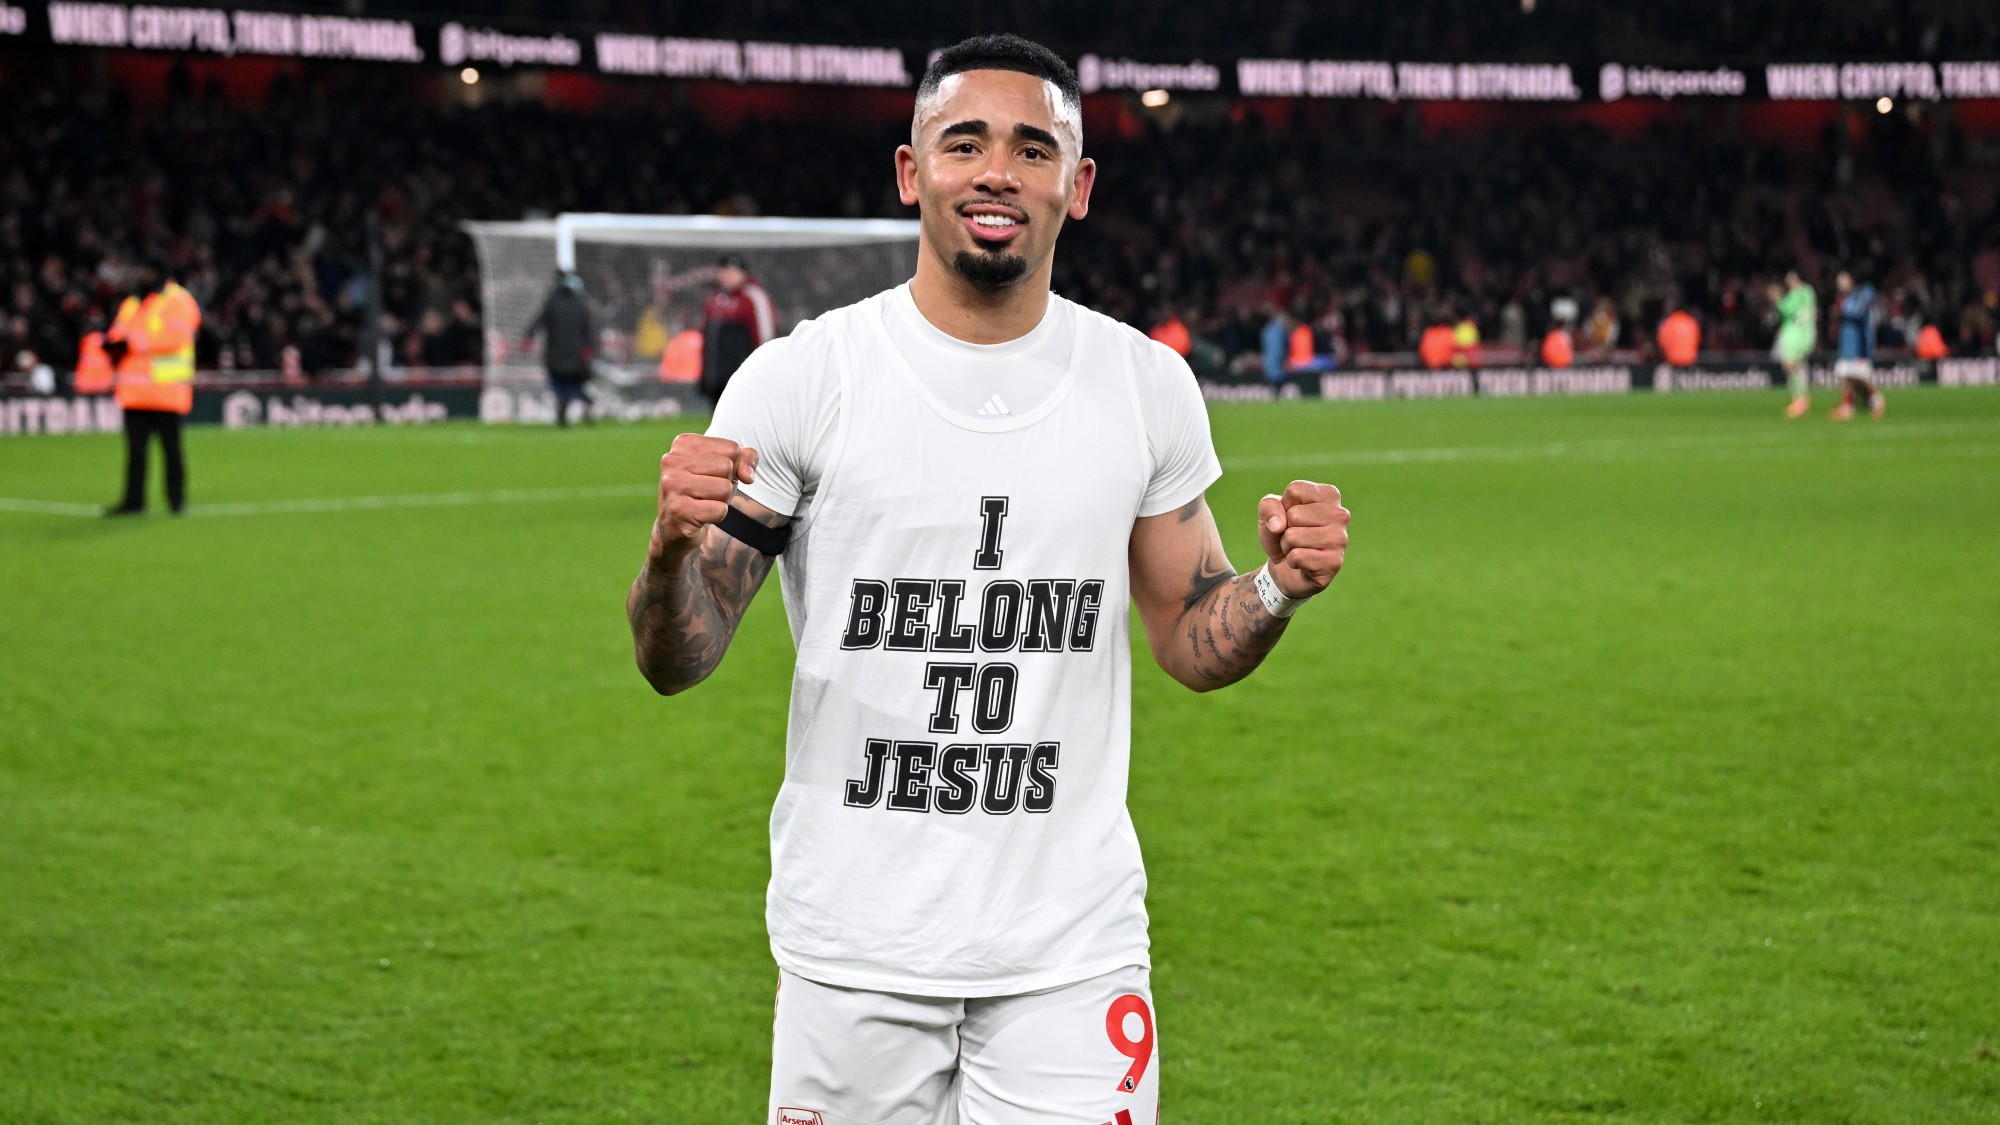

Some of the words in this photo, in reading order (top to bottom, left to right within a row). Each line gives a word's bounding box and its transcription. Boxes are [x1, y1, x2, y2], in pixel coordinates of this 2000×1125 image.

[973, 496, 1009, 570] I
[840, 578, 1105, 653] BELONG
[923, 662, 1019, 735] TO
[844, 738, 1060, 815] JESUS
[1105, 993, 1154, 1094] 9
[782, 1115, 816, 1125] Arsenal
